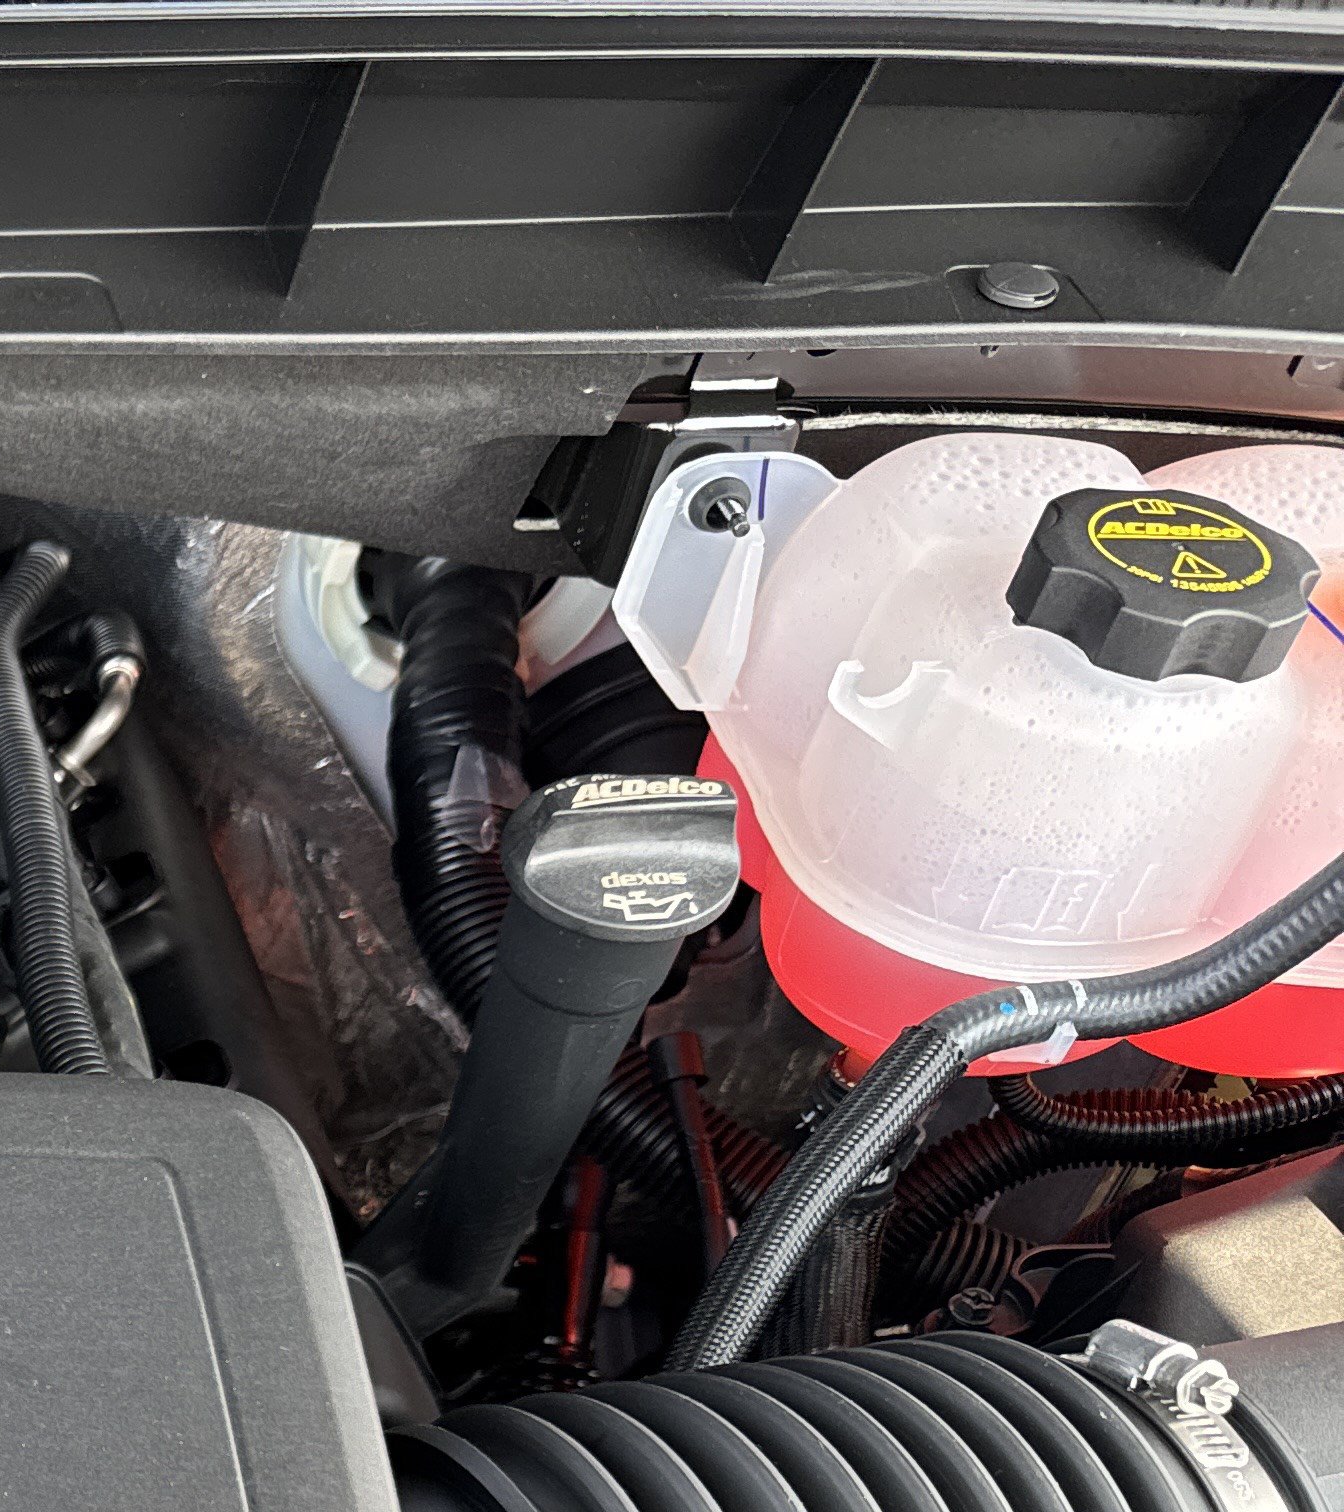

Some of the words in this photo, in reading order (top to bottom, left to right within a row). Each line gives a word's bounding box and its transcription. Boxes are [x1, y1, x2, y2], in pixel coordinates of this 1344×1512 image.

[1099, 521, 1244, 538] ACDelco
[571, 777, 722, 803] ACDelco
[600, 872, 687, 888] dexos
